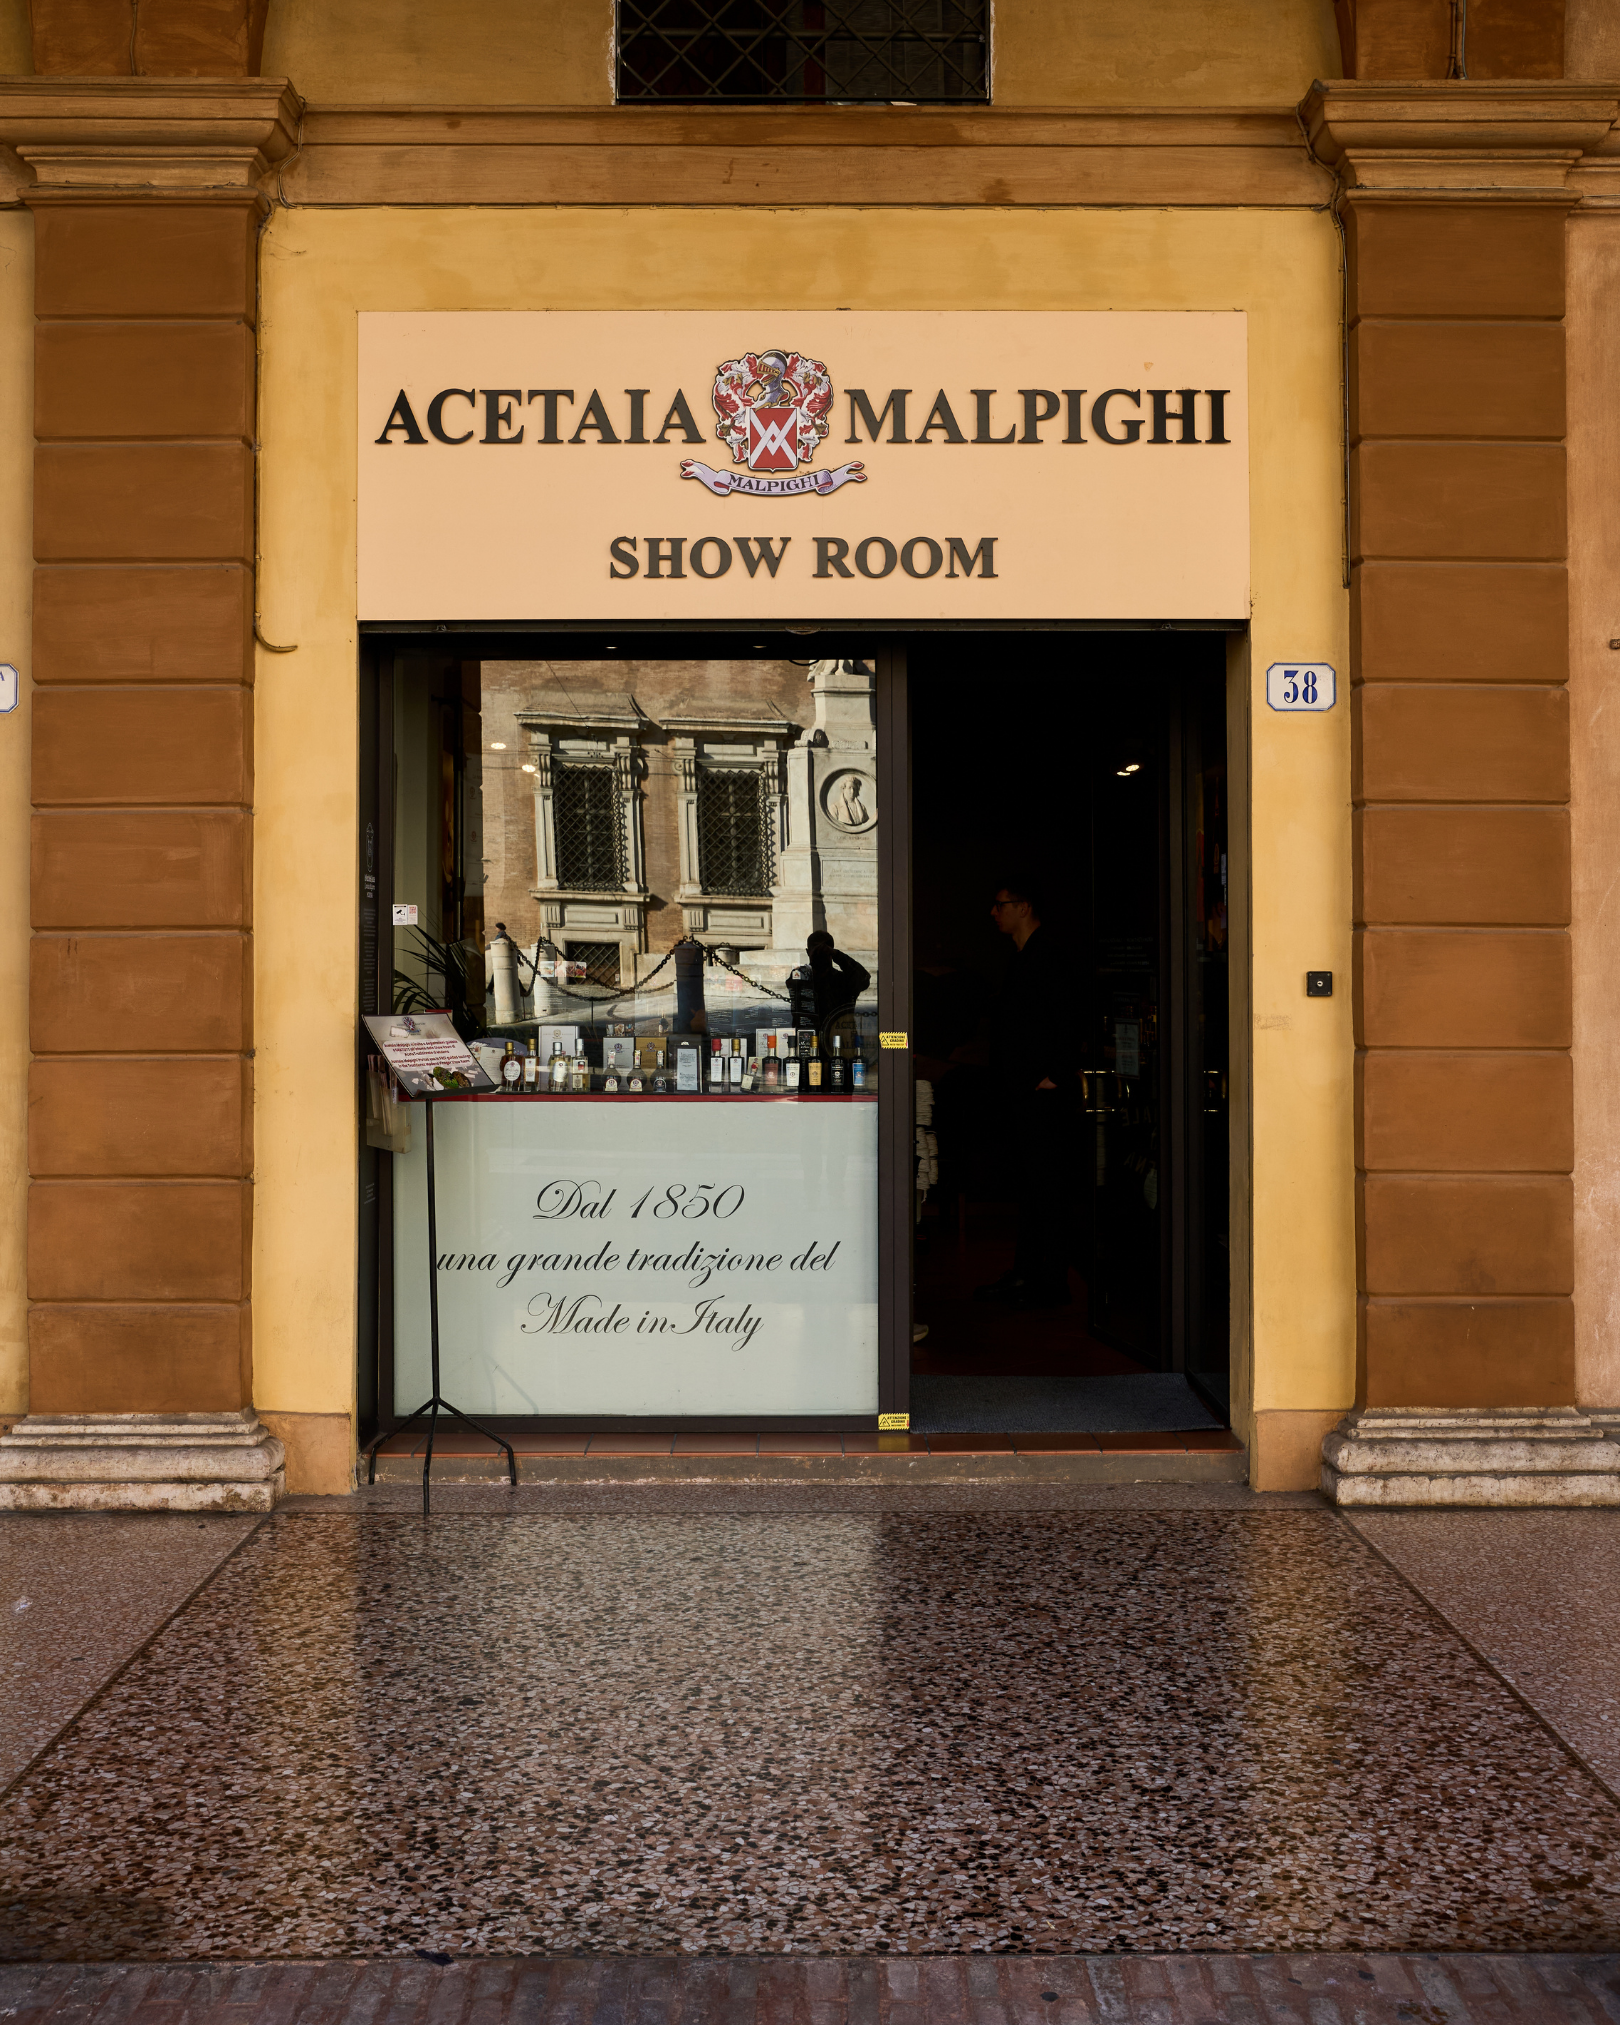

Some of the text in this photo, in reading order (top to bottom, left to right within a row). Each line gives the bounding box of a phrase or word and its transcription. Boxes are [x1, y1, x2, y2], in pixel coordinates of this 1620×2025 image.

[375, 388, 1232, 445] ACETAIA MALPIGHI
[727, 473, 822, 492] MALPIGHI
[610, 536, 998, 579] SHOW ROOM
[1283, 669, 1318, 705] 38
[533, 1180, 745, 1219] Dal 1850
[437, 1241, 841, 1288] una grande tradizione del
[520, 1292, 765, 1351] Made in Italy
